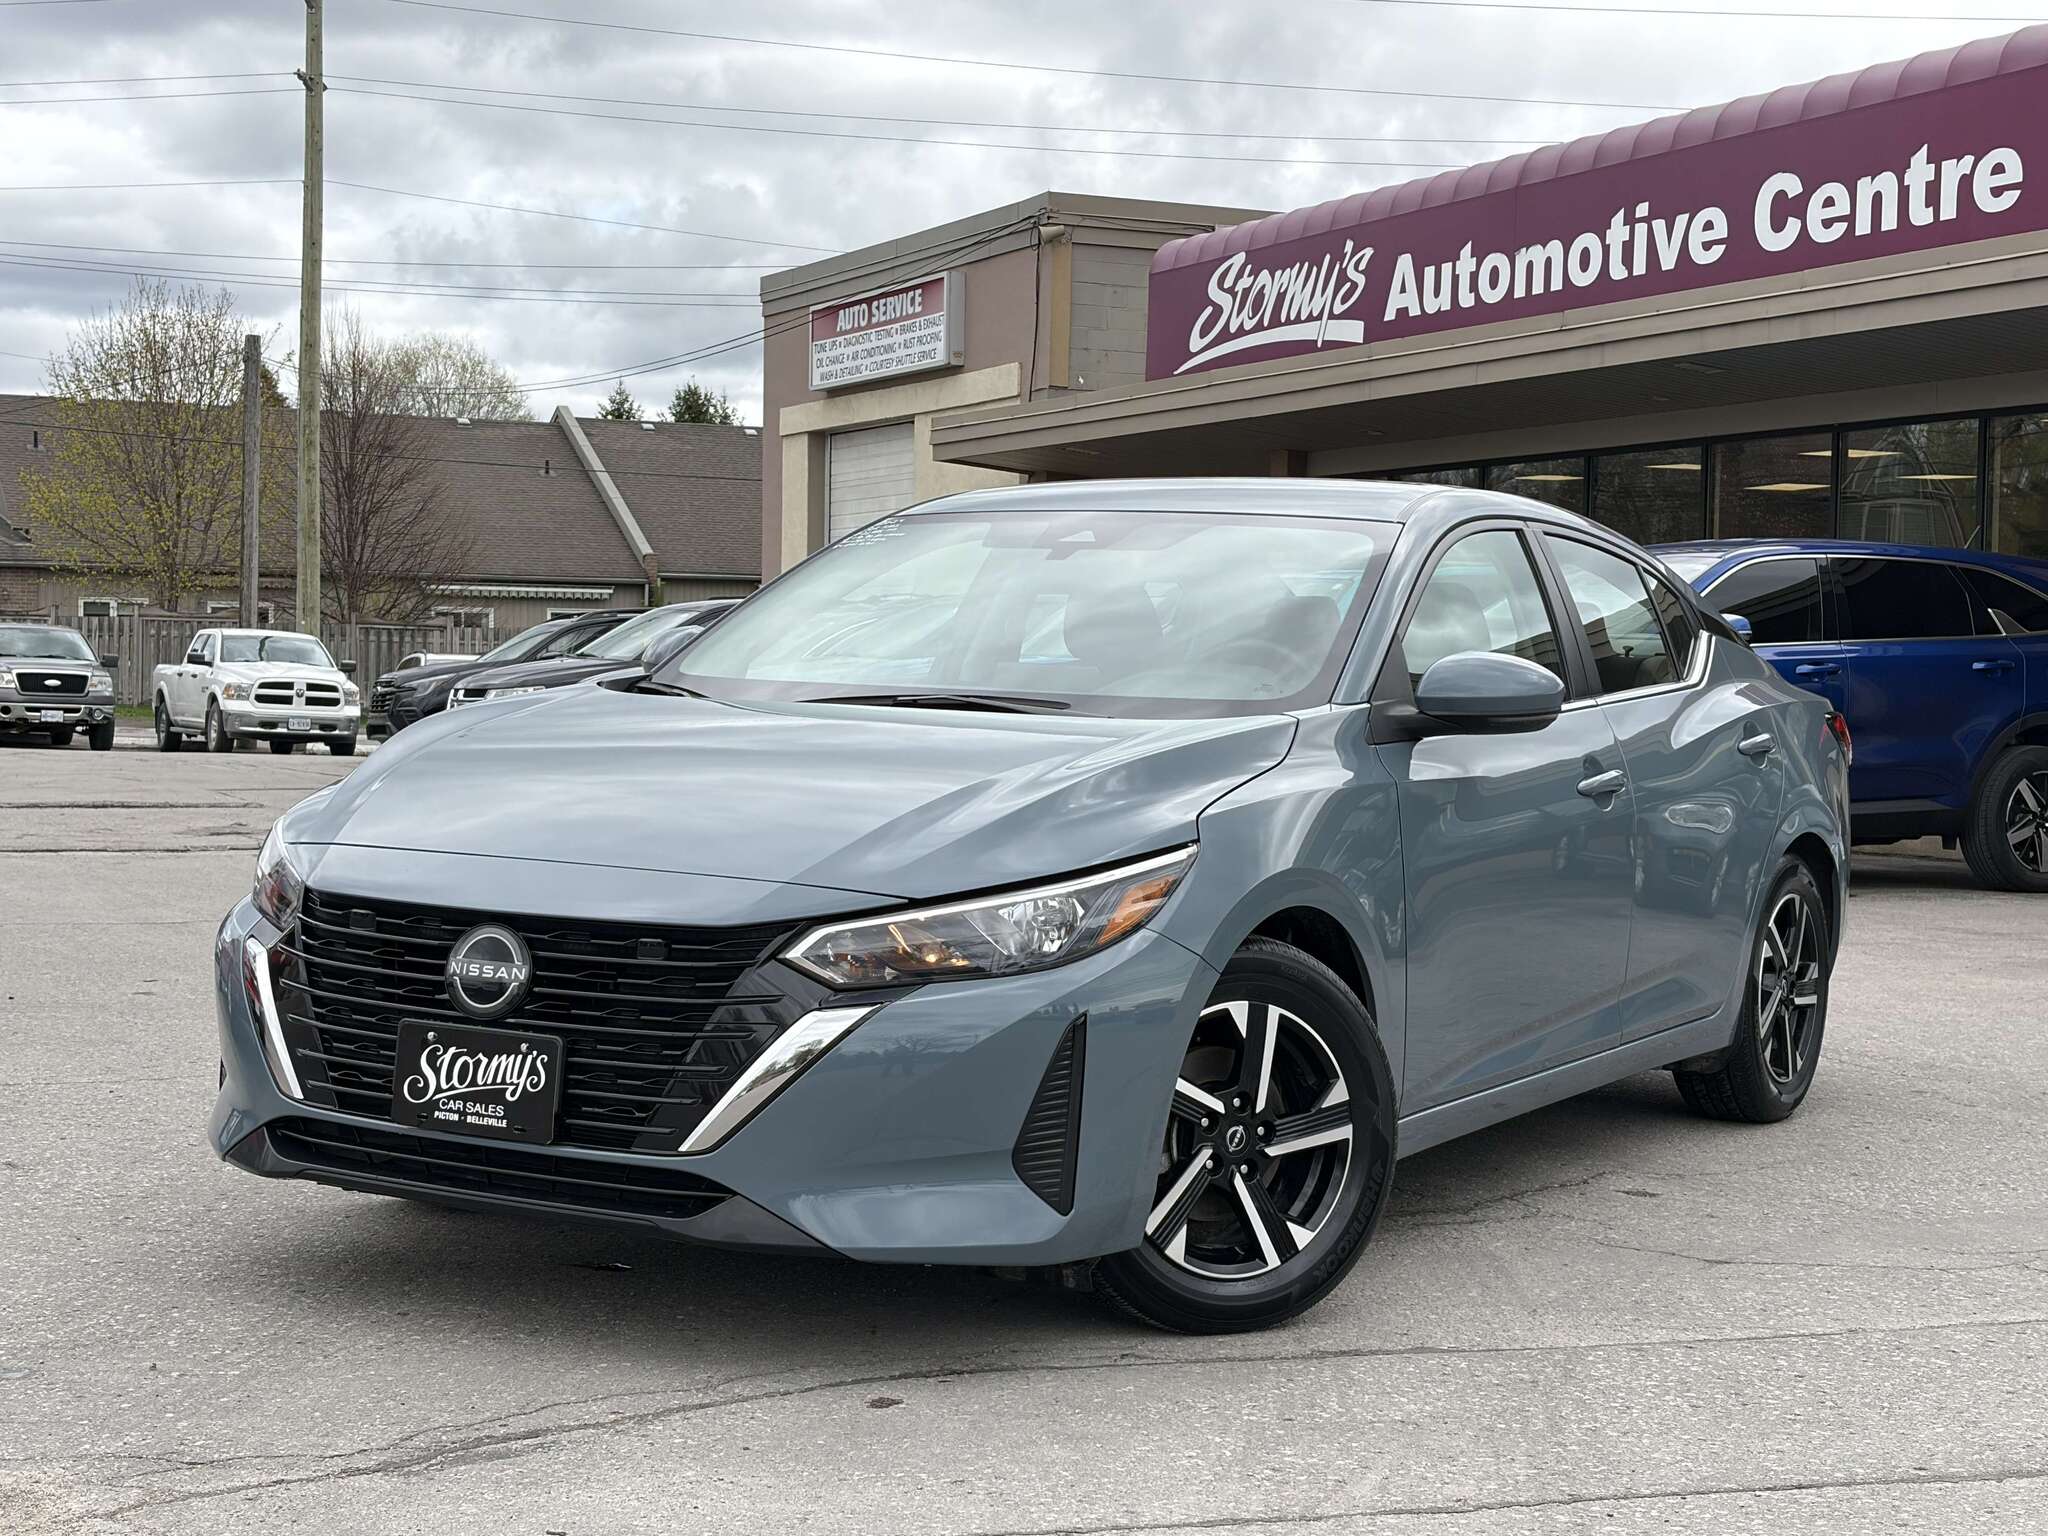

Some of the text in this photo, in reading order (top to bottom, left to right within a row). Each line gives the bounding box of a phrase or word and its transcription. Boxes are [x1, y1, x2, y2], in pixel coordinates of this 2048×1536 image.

[1189, 143, 2025, 349] Stormy's Automotive Centre
[836, 288, 922, 332] AUTO SERVICE
[814, 342, 827, 354] TUNE
[828, 340, 837, 351] UPS
[843, 333, 873, 348] DIAGNOSTIC
[875, 328, 894, 341] TESTING
[900, 321, 917, 335] BRAKES
[923, 315, 944, 330] EXHAUST
[816, 331, 943, 369] OIL CHANGE AIR CONDITIONING RUST PROOFING
[819, 370, 833, 382] WASH
[839, 363, 863, 378] DETAILING
[869, 358, 894, 373] COURTESY
[894, 352, 916, 367] SHUTTLE
[917, 348, 937, 363] SERVICE
[449, 960, 527, 981] NISSAN
[402, 1043, 549, 1104] Stormy's
[434, 1110, 459, 1121] PICTON
[466, 1115, 508, 1128] BELLEVILLE
[439, 1098, 505, 1117] CAR SALES
